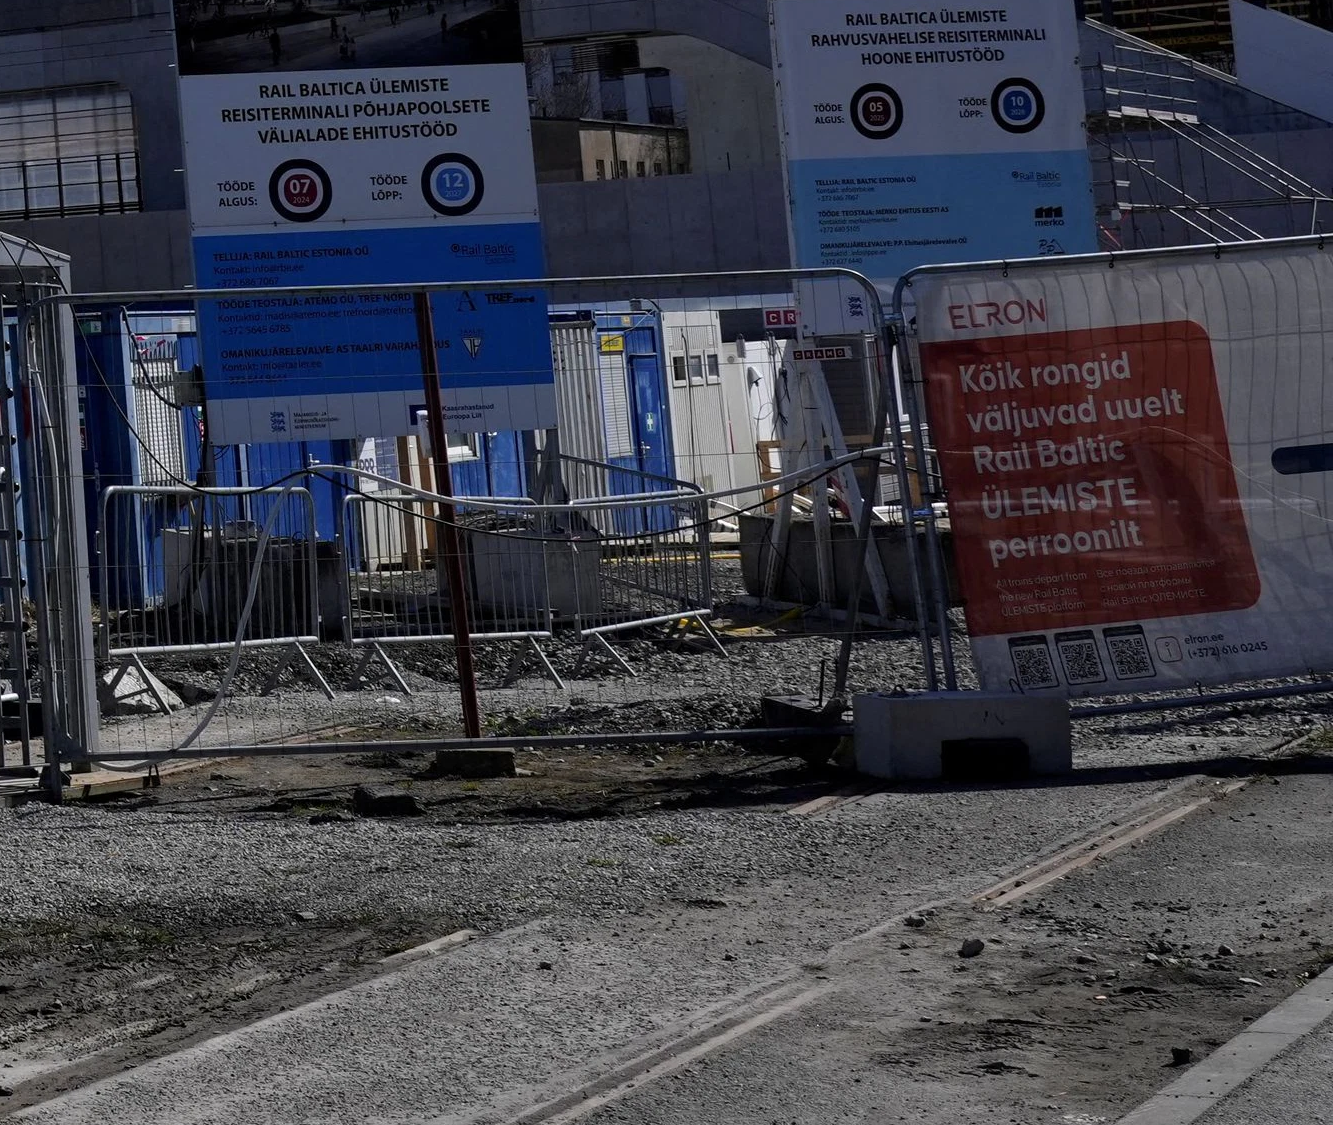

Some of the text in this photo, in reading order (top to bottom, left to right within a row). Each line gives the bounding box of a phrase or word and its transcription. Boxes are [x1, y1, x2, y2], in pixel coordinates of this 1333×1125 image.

[845, 7, 1008, 27] RAIL BALTICA ÜLEMISTE
[811, 27, 1047, 48] RAHVUSVAHELISE REISITERMINALI
[861, 47, 1005, 66] HOONE EHITUSTÖÖD
[258, 76, 449, 100] RAIL BALTICA ÜLEMISTE
[813, 102, 843, 114] TÖÖDE
[869, 101, 885, 114] 05
[959, 96, 988, 109] TÖÖDE
[1011, 95, 1025, 108] 10
[221, 97, 491, 123] REISITERMINALI PÕHJAPOOLSETE
[960, 108, 984, 120] LÕPP:
[814, 114, 845, 126] ALGUS:
[258, 120, 458, 144] VÄLIALADE EHITUSTÖÖD
[217, 179, 256, 194] TÖÖDE
[289, 179, 312, 195] 07
[370, 175, 408, 188] TÖÖDE
[442, 172, 464, 189] 12
[218, 196, 258, 209] ALGUS:
[292, 195, 311, 205] 2024
[371, 188, 403, 203] LÕPP:
[1035, 219, 1064, 227] merko
[254, 251, 275, 261] RAIL
[277, 250, 310, 259] BALTIC
[311, 247, 351, 258] ESTONIA
[354, 245, 369, 256] OÜ
[461, 244, 515, 255] Rail Baltic
[252, 297, 302, 309] TEOSTAJA:
[304, 296, 338, 306] ATEMO
[383, 292, 412, 302] NORD
[948, 298, 1047, 330] ELRON
[793, 348, 846, 360] CRAMO
[959, 351, 1131, 393] Kõik rongid
[966, 388, 1185, 437] väljuvad uuelt
[973, 434, 1126, 474] Rail Baltic
[981, 477, 1139, 521] ÜLEMISTE
[989, 522, 1144, 568] perroonilt
[1184, 631, 1224, 645] elron.ee
[1187, 645, 1221, 660] (+372)
[1240, 641, 1269, 655] 0245
